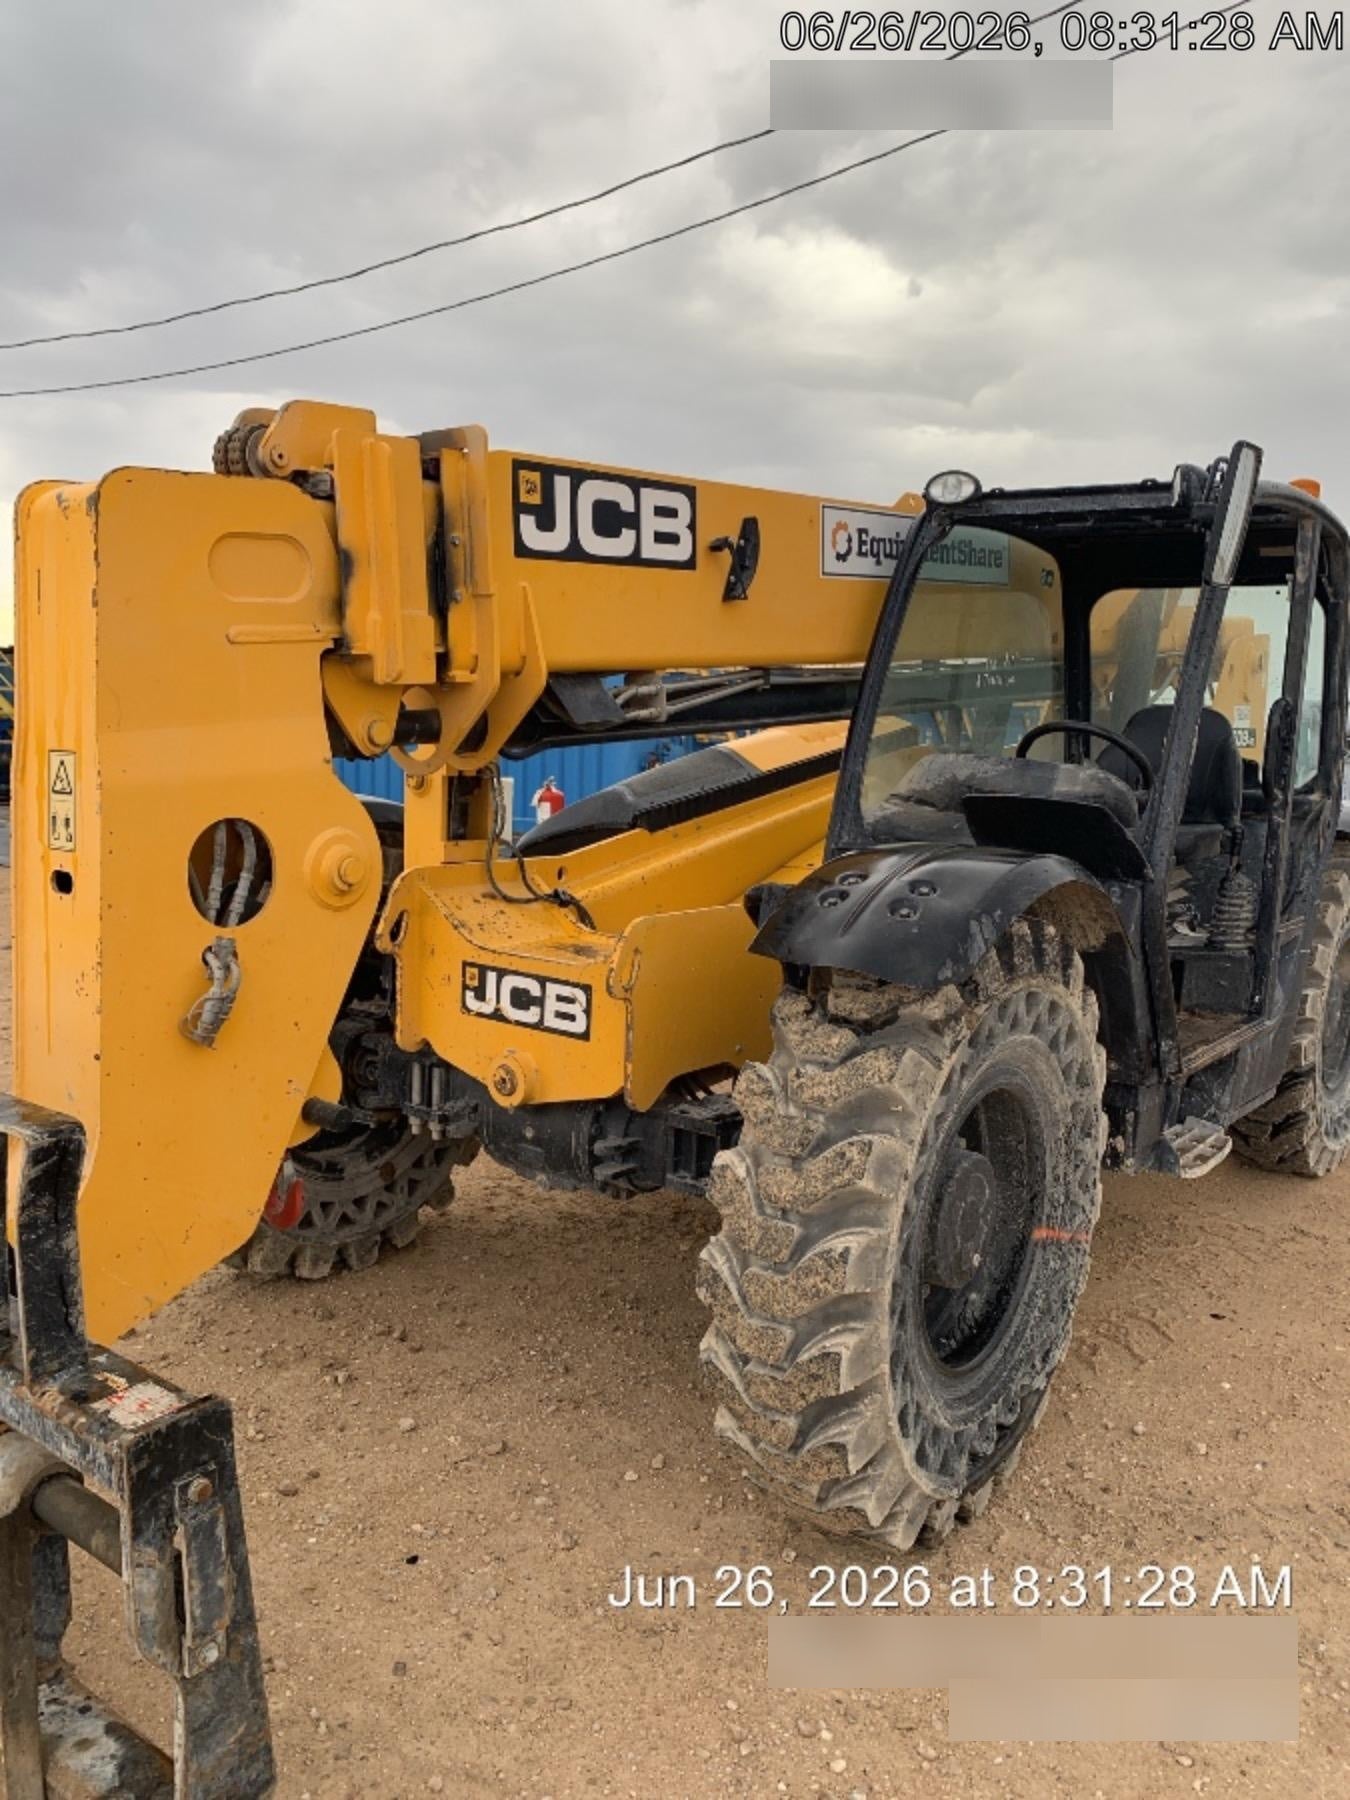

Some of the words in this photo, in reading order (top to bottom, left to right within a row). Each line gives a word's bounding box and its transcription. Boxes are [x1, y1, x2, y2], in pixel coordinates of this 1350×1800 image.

[519, 473, 693, 562] JCB
[856, 527, 1004, 569] EquientShare
[465, 970, 588, 1034] JCB
